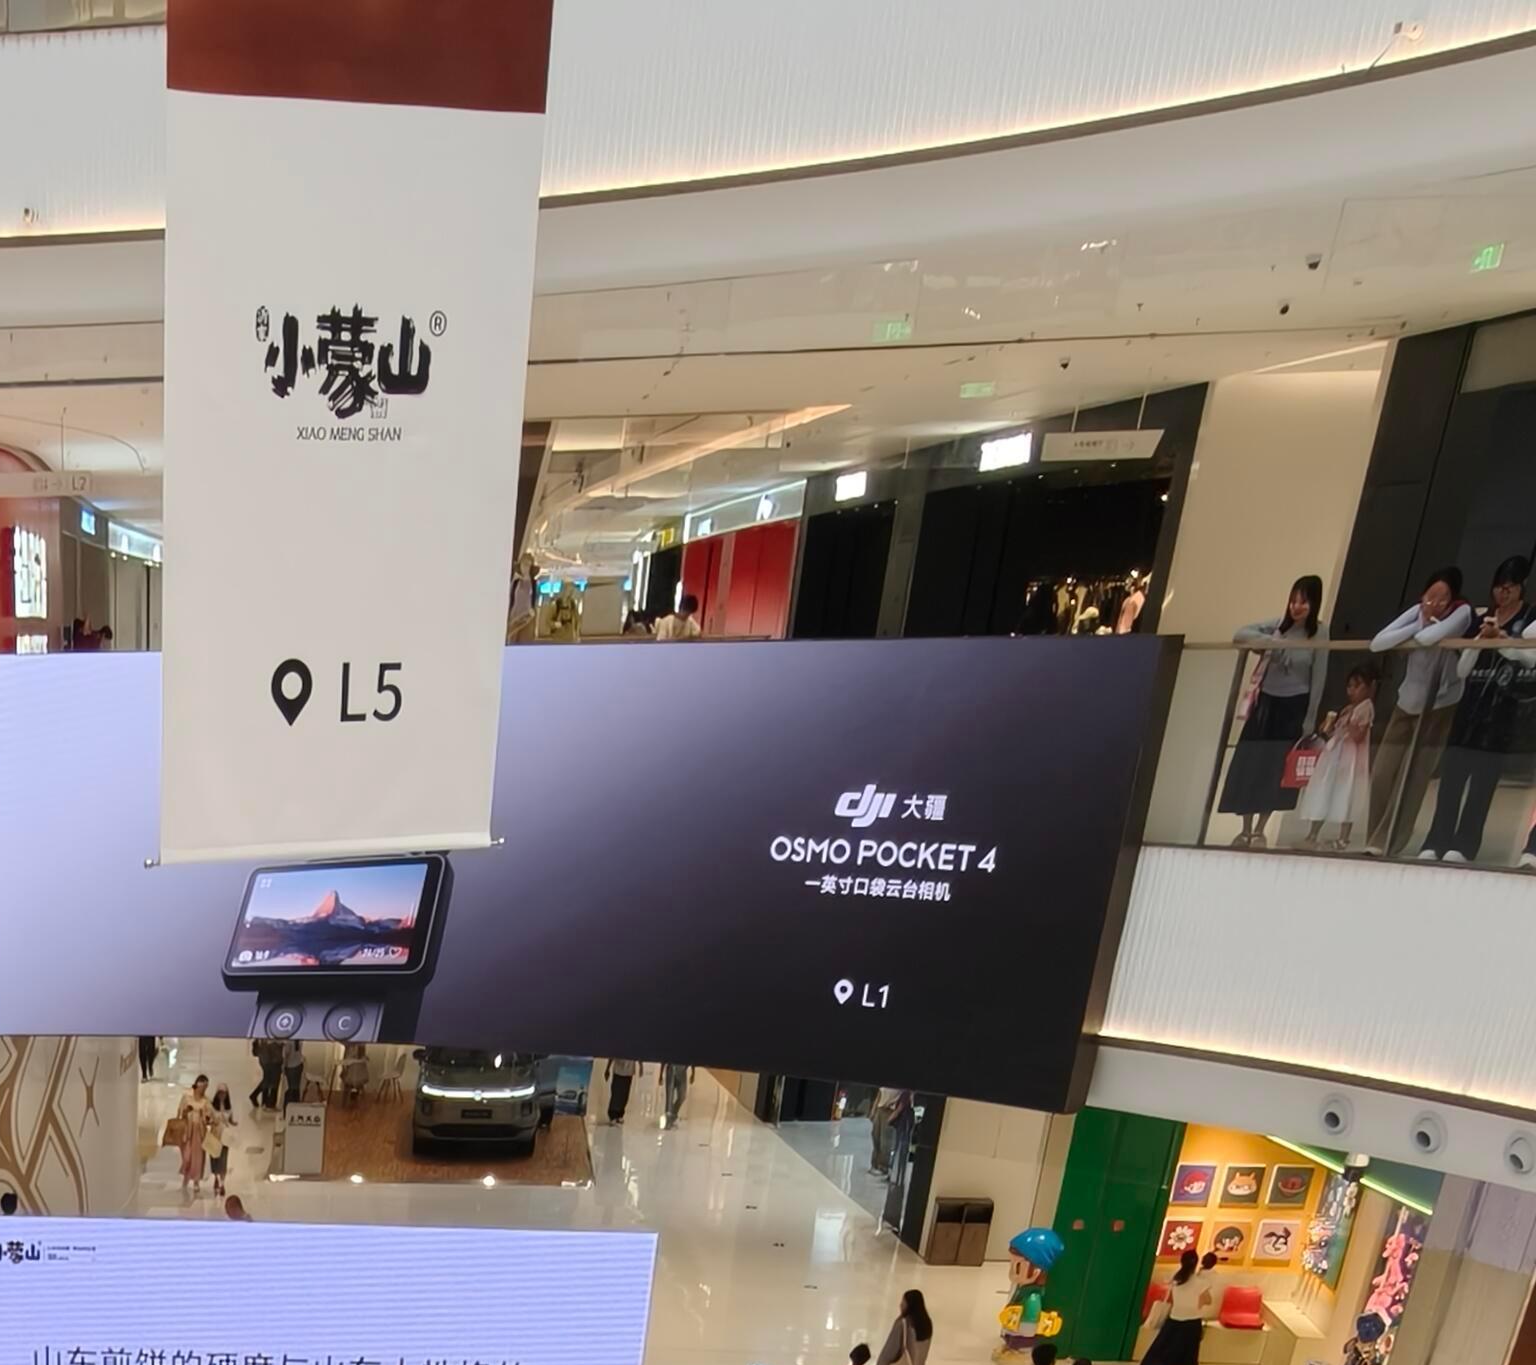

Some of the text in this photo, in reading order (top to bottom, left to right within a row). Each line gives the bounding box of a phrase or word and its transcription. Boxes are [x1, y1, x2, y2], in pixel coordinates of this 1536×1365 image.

[264, 303, 431, 419] 小蒙山
[296, 426, 402, 442] XIAO MENG SHAN
[339, 661, 403, 722] L5
[901, 794, 948, 821] 大疆
[770, 836, 998, 873] OSMO POCKET 4
[804, 874, 952, 902] 一英寸口袋云台相机
[861, 983, 890, 1008] L1
